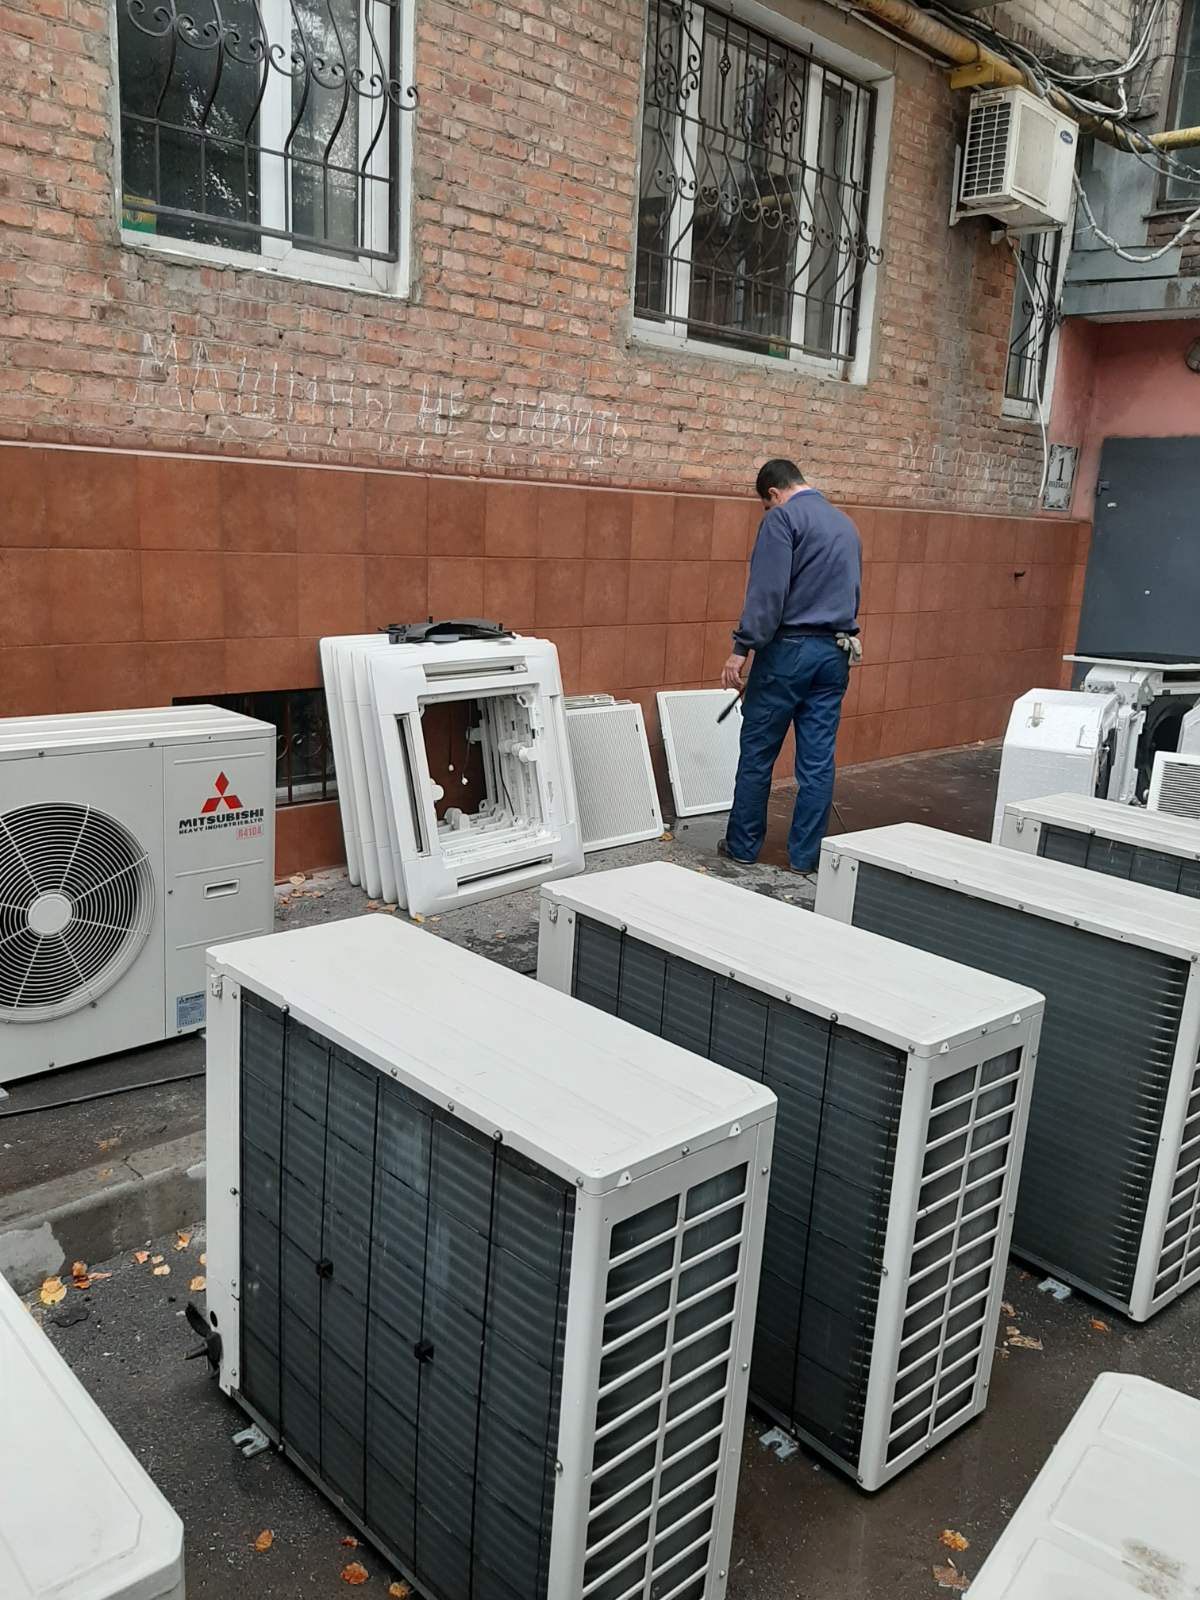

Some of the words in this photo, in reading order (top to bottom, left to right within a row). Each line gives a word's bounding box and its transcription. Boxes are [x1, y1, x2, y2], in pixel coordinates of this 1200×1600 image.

[417, 382, 464, 435] НЕ
[487, 397, 628, 456] СТАВИТЬ
[1056, 457, 1065, 481] 1
[179, 808, 264, 828] MITSUBISHI
[179, 826, 204, 834] HEAVY
